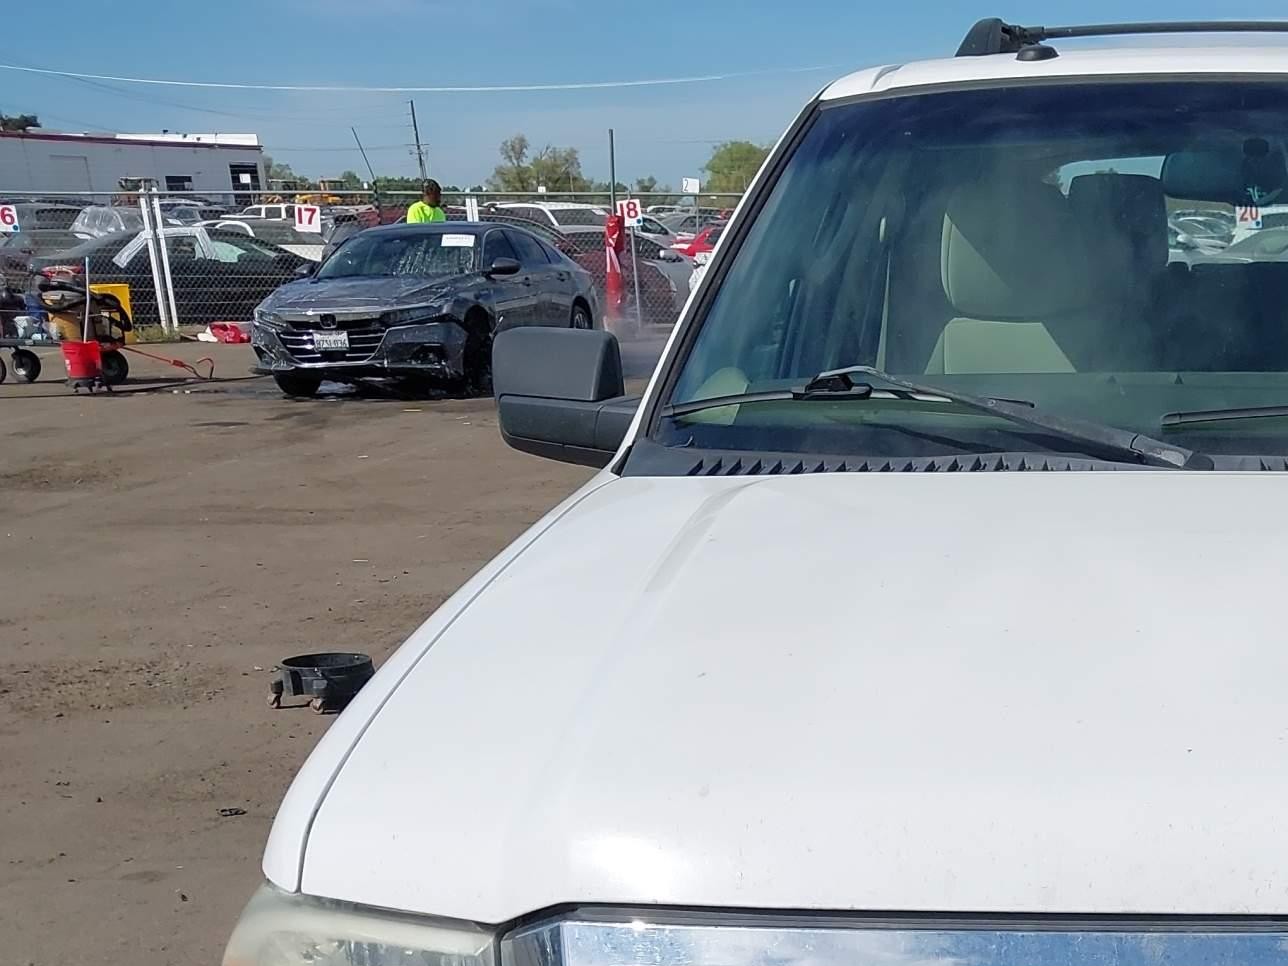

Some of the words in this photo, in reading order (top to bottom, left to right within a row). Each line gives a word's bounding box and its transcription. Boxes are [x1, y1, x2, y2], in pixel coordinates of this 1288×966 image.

[297, 206, 317, 225] 17
[619, 201, 638, 219] 18
[1239, 205, 1259, 222] 20
